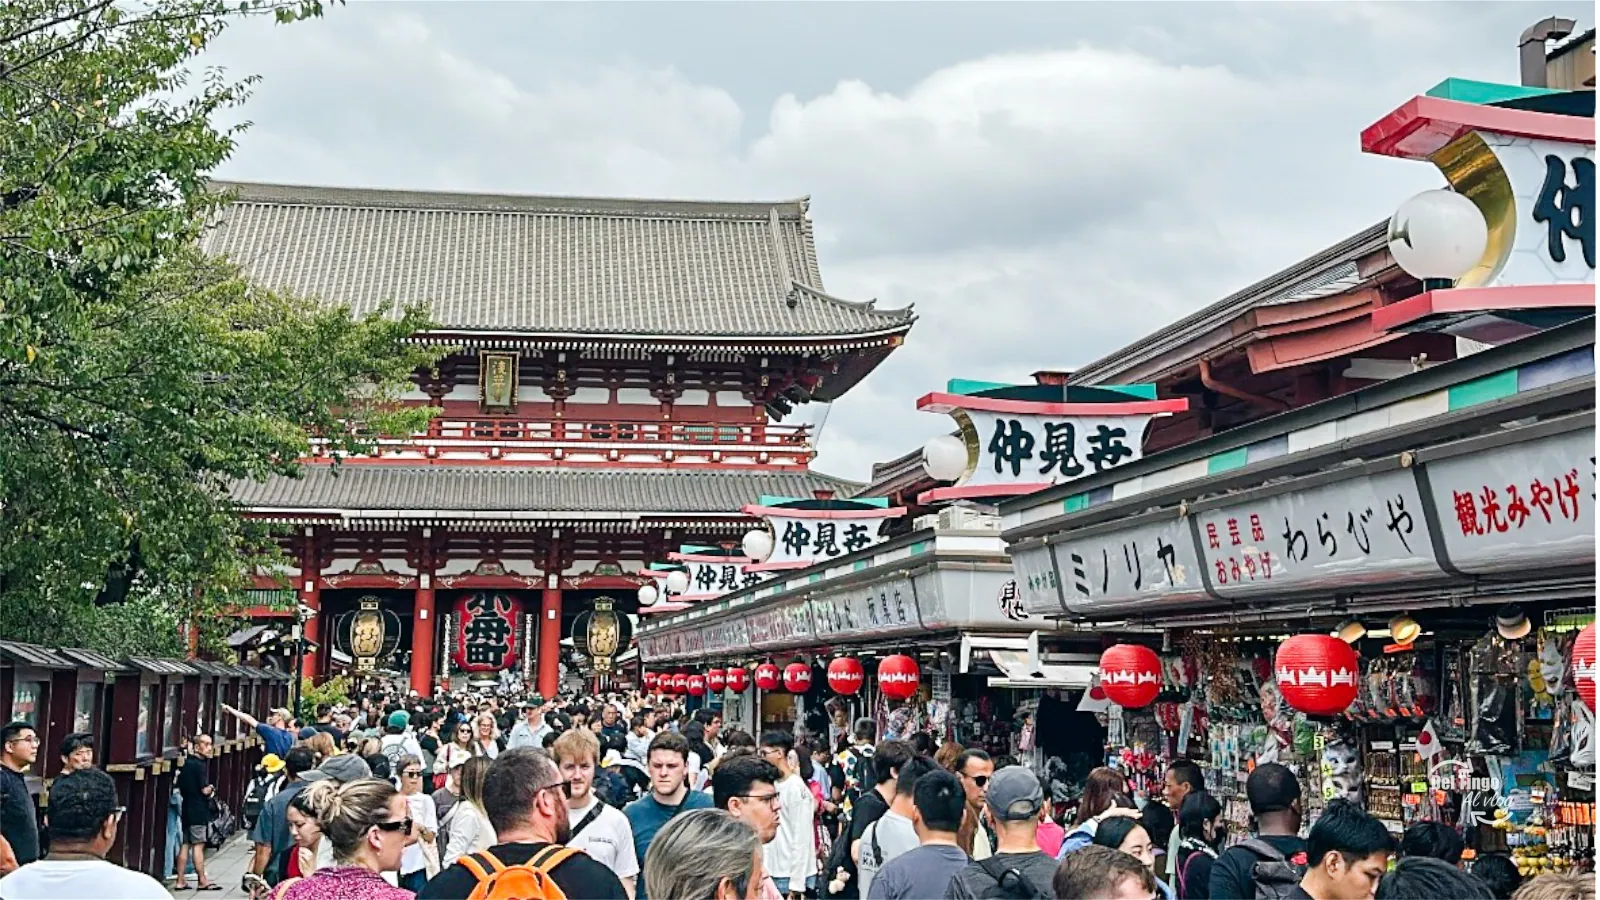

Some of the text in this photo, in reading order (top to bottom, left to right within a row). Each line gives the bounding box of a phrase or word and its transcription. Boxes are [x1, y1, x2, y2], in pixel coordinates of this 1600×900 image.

[1205, 513, 1266, 549] 民芸品
[1282, 493, 1414, 564] わらびや
[1452, 467, 1581, 537] 観光みやげ
[1070, 536, 1177, 597] ミノリヤ
[1214, 550, 1273, 585] おみやげ
